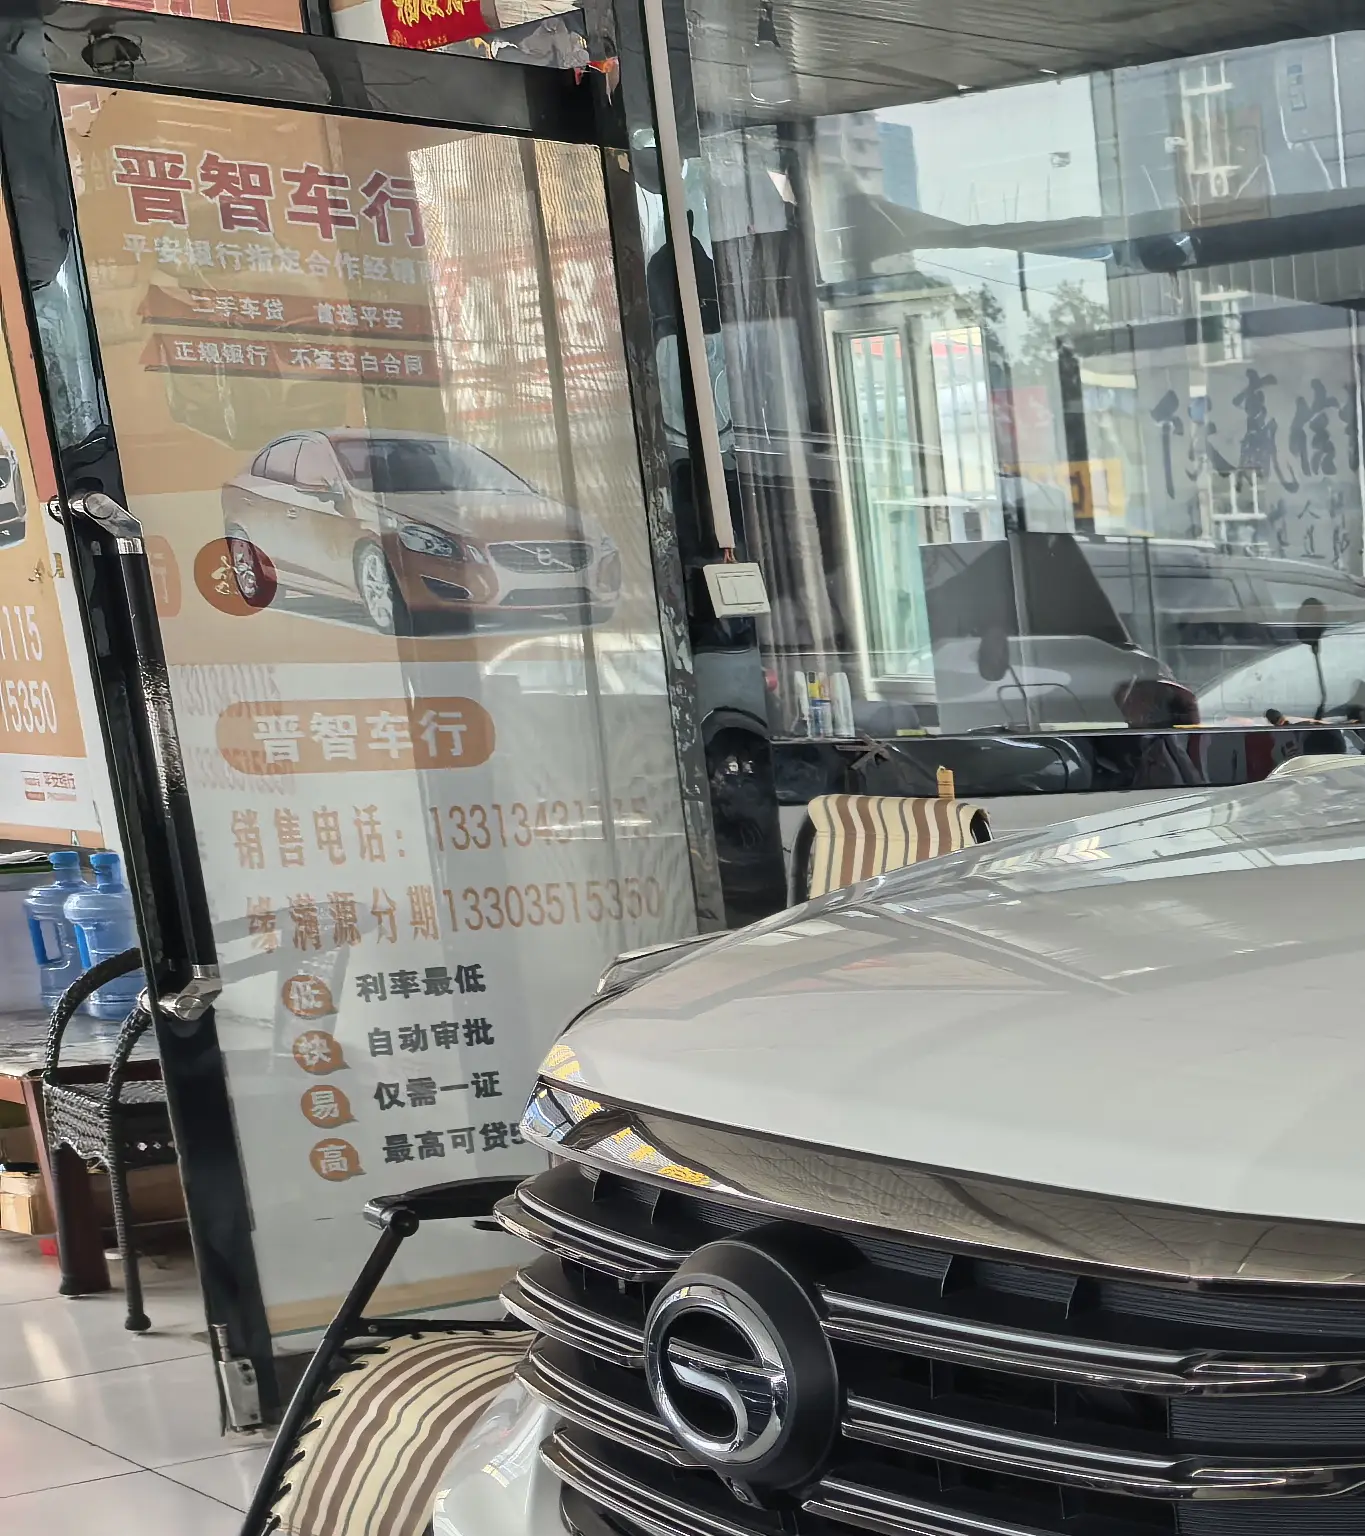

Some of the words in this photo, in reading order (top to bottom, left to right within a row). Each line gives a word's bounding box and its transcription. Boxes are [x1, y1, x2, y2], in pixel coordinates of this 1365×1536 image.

[112, 145, 425, 248] 晋智车行
[123, 233, 431, 284] 平安银行指定合作经销
[192, 291, 285, 321] 二手车贷
[175, 341, 269, 366] 正规银行
[290, 347, 423, 376] 不签空白合同
[253, 710, 467, 764] 晋智车行
[429, 796, 650, 853] 1331343115
[441, 876, 661, 932] 13303515350
[355, 964, 487, 1003] 利率最低
[299, 1034, 332, 1067] 快
[368, 1018, 495, 1058] 自动审批
[311, 1090, 340, 1120] 易
[373, 1070, 503, 1111] 仅需一证
[315, 1143, 349, 1173] 高
